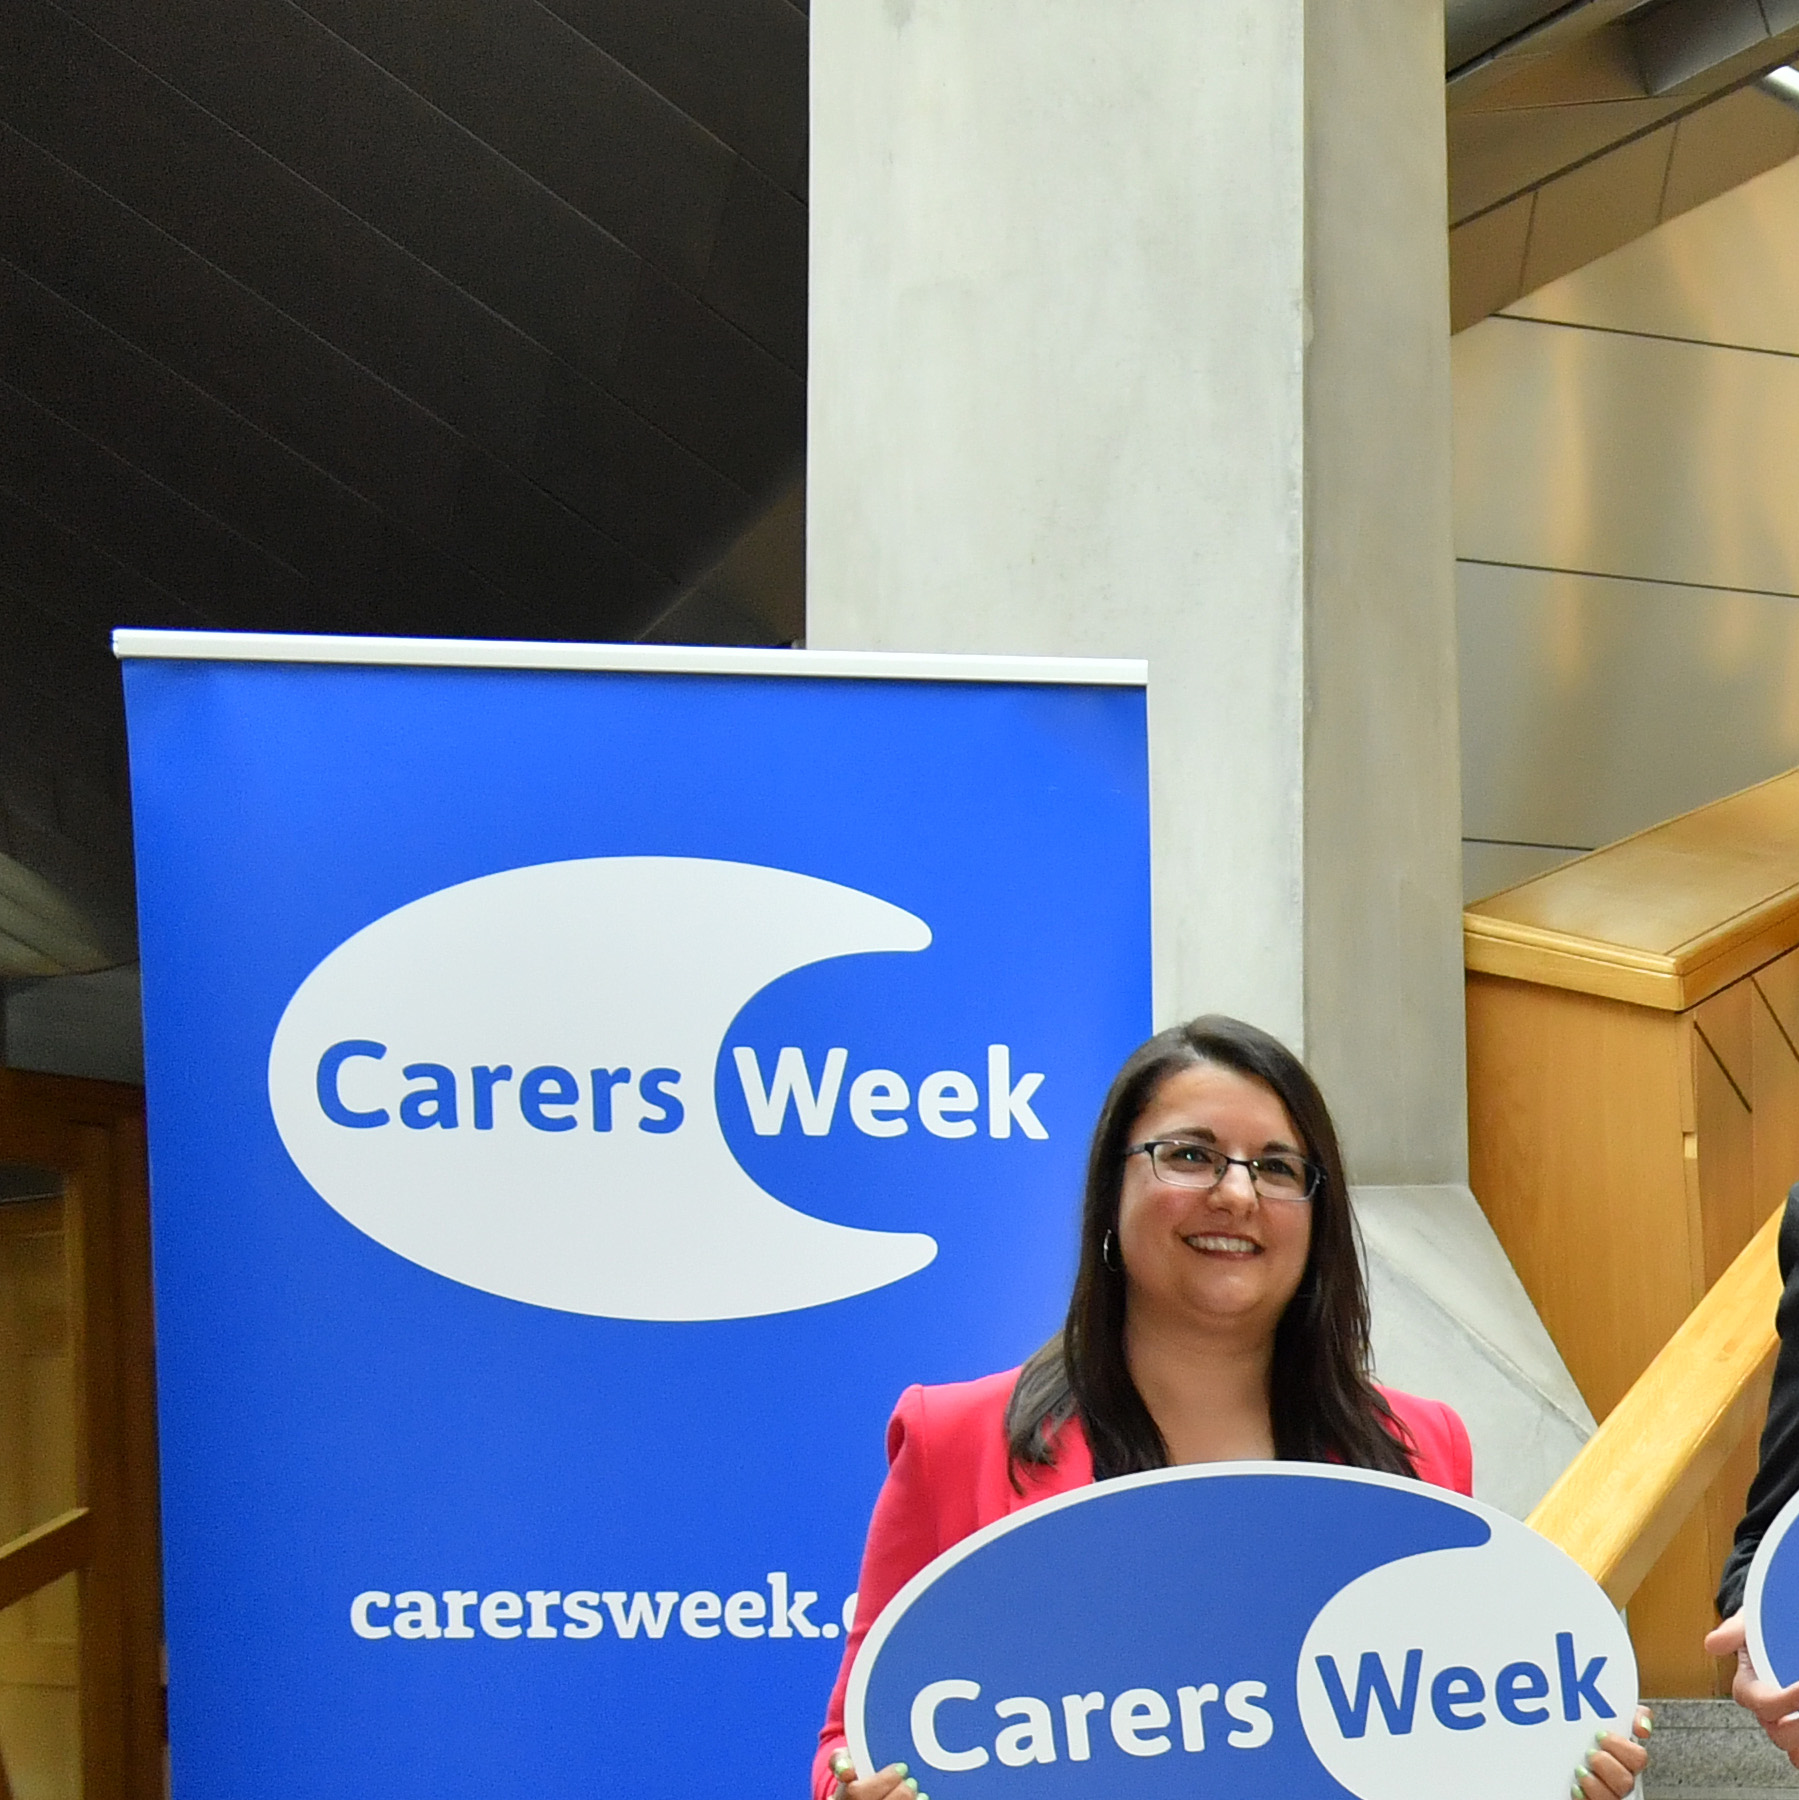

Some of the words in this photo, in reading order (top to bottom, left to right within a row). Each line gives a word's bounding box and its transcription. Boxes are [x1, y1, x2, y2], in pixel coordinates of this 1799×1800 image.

[314, 1039, 685, 1134] Carers
[732, 1044, 1048, 1140] Week
[909, 1678, 1273, 1772] Carers
[1315, 1631, 1617, 1739] Week
